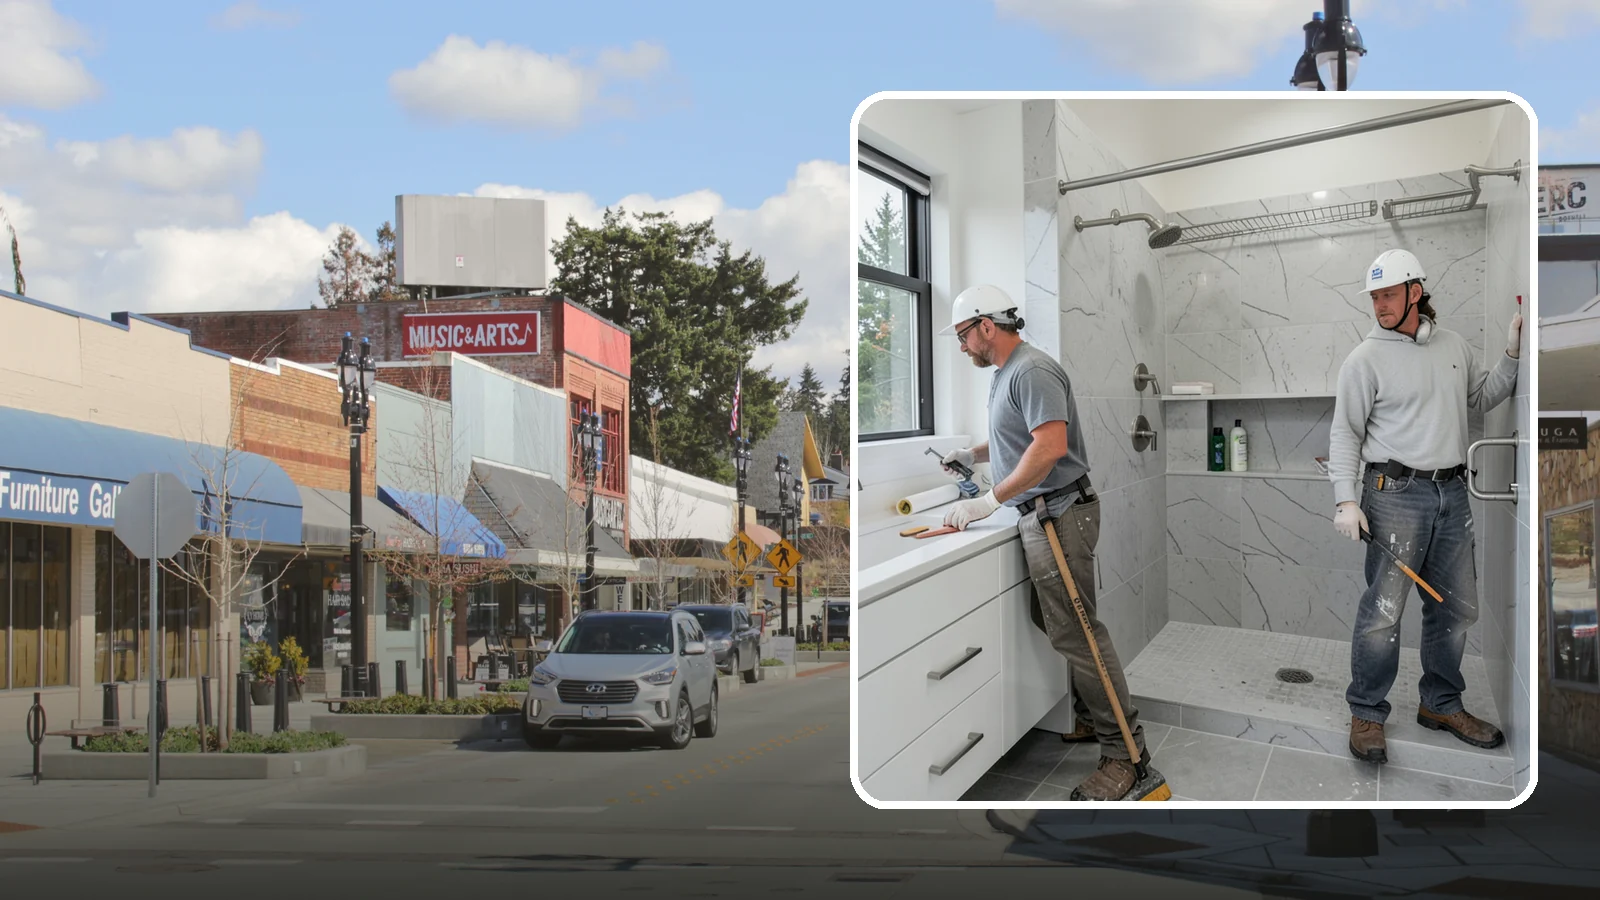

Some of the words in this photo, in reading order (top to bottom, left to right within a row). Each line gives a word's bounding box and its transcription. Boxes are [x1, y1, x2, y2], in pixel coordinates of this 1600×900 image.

[409, 323, 519, 348] MUSIC&ARTS
[1540, 427, 1577, 436] UGA
[0, 471, 79, 515] Furniture
[89, 482, 122, 519] Gal
[453, 563, 479, 574] SUSHI
